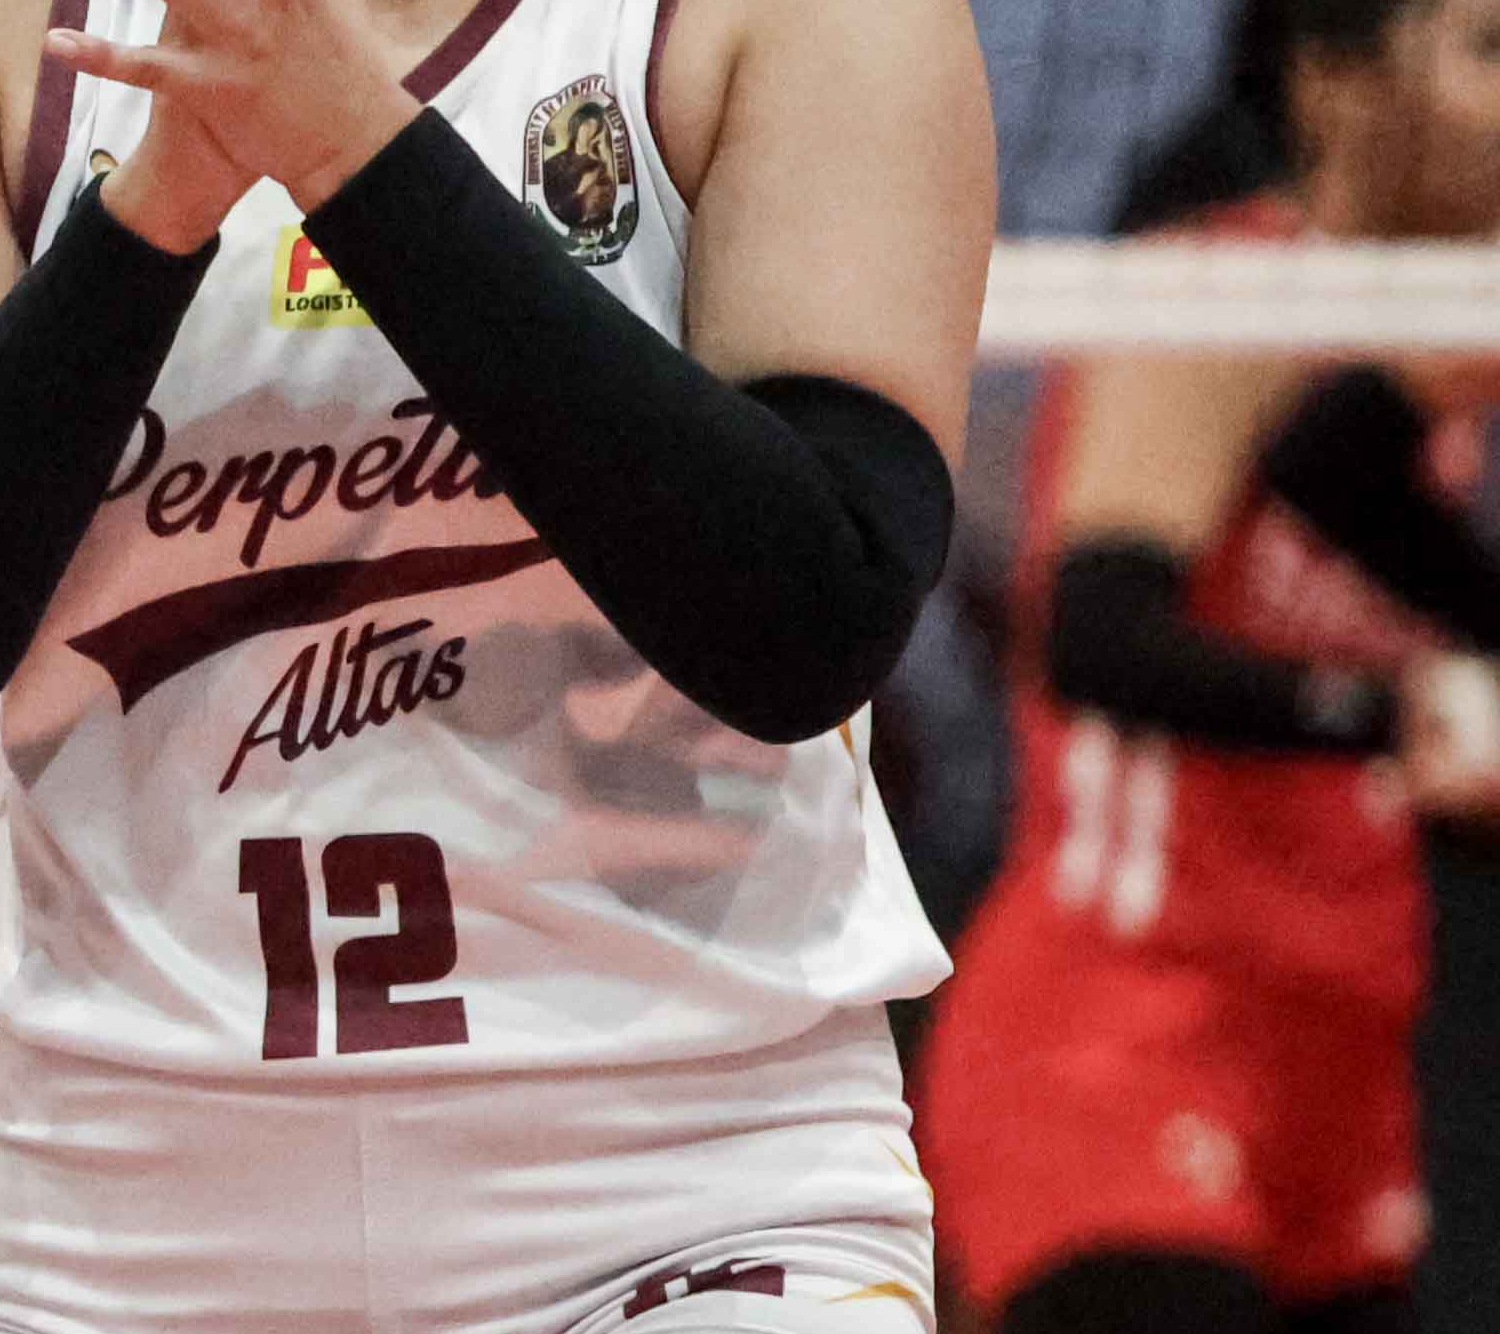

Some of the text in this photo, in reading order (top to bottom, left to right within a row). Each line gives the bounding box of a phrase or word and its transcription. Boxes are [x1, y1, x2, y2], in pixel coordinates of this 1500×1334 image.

[284, 293, 363, 313] LOGIST
[218, 618, 467, 794] Altas
[238, 832, 470, 1060] 12
